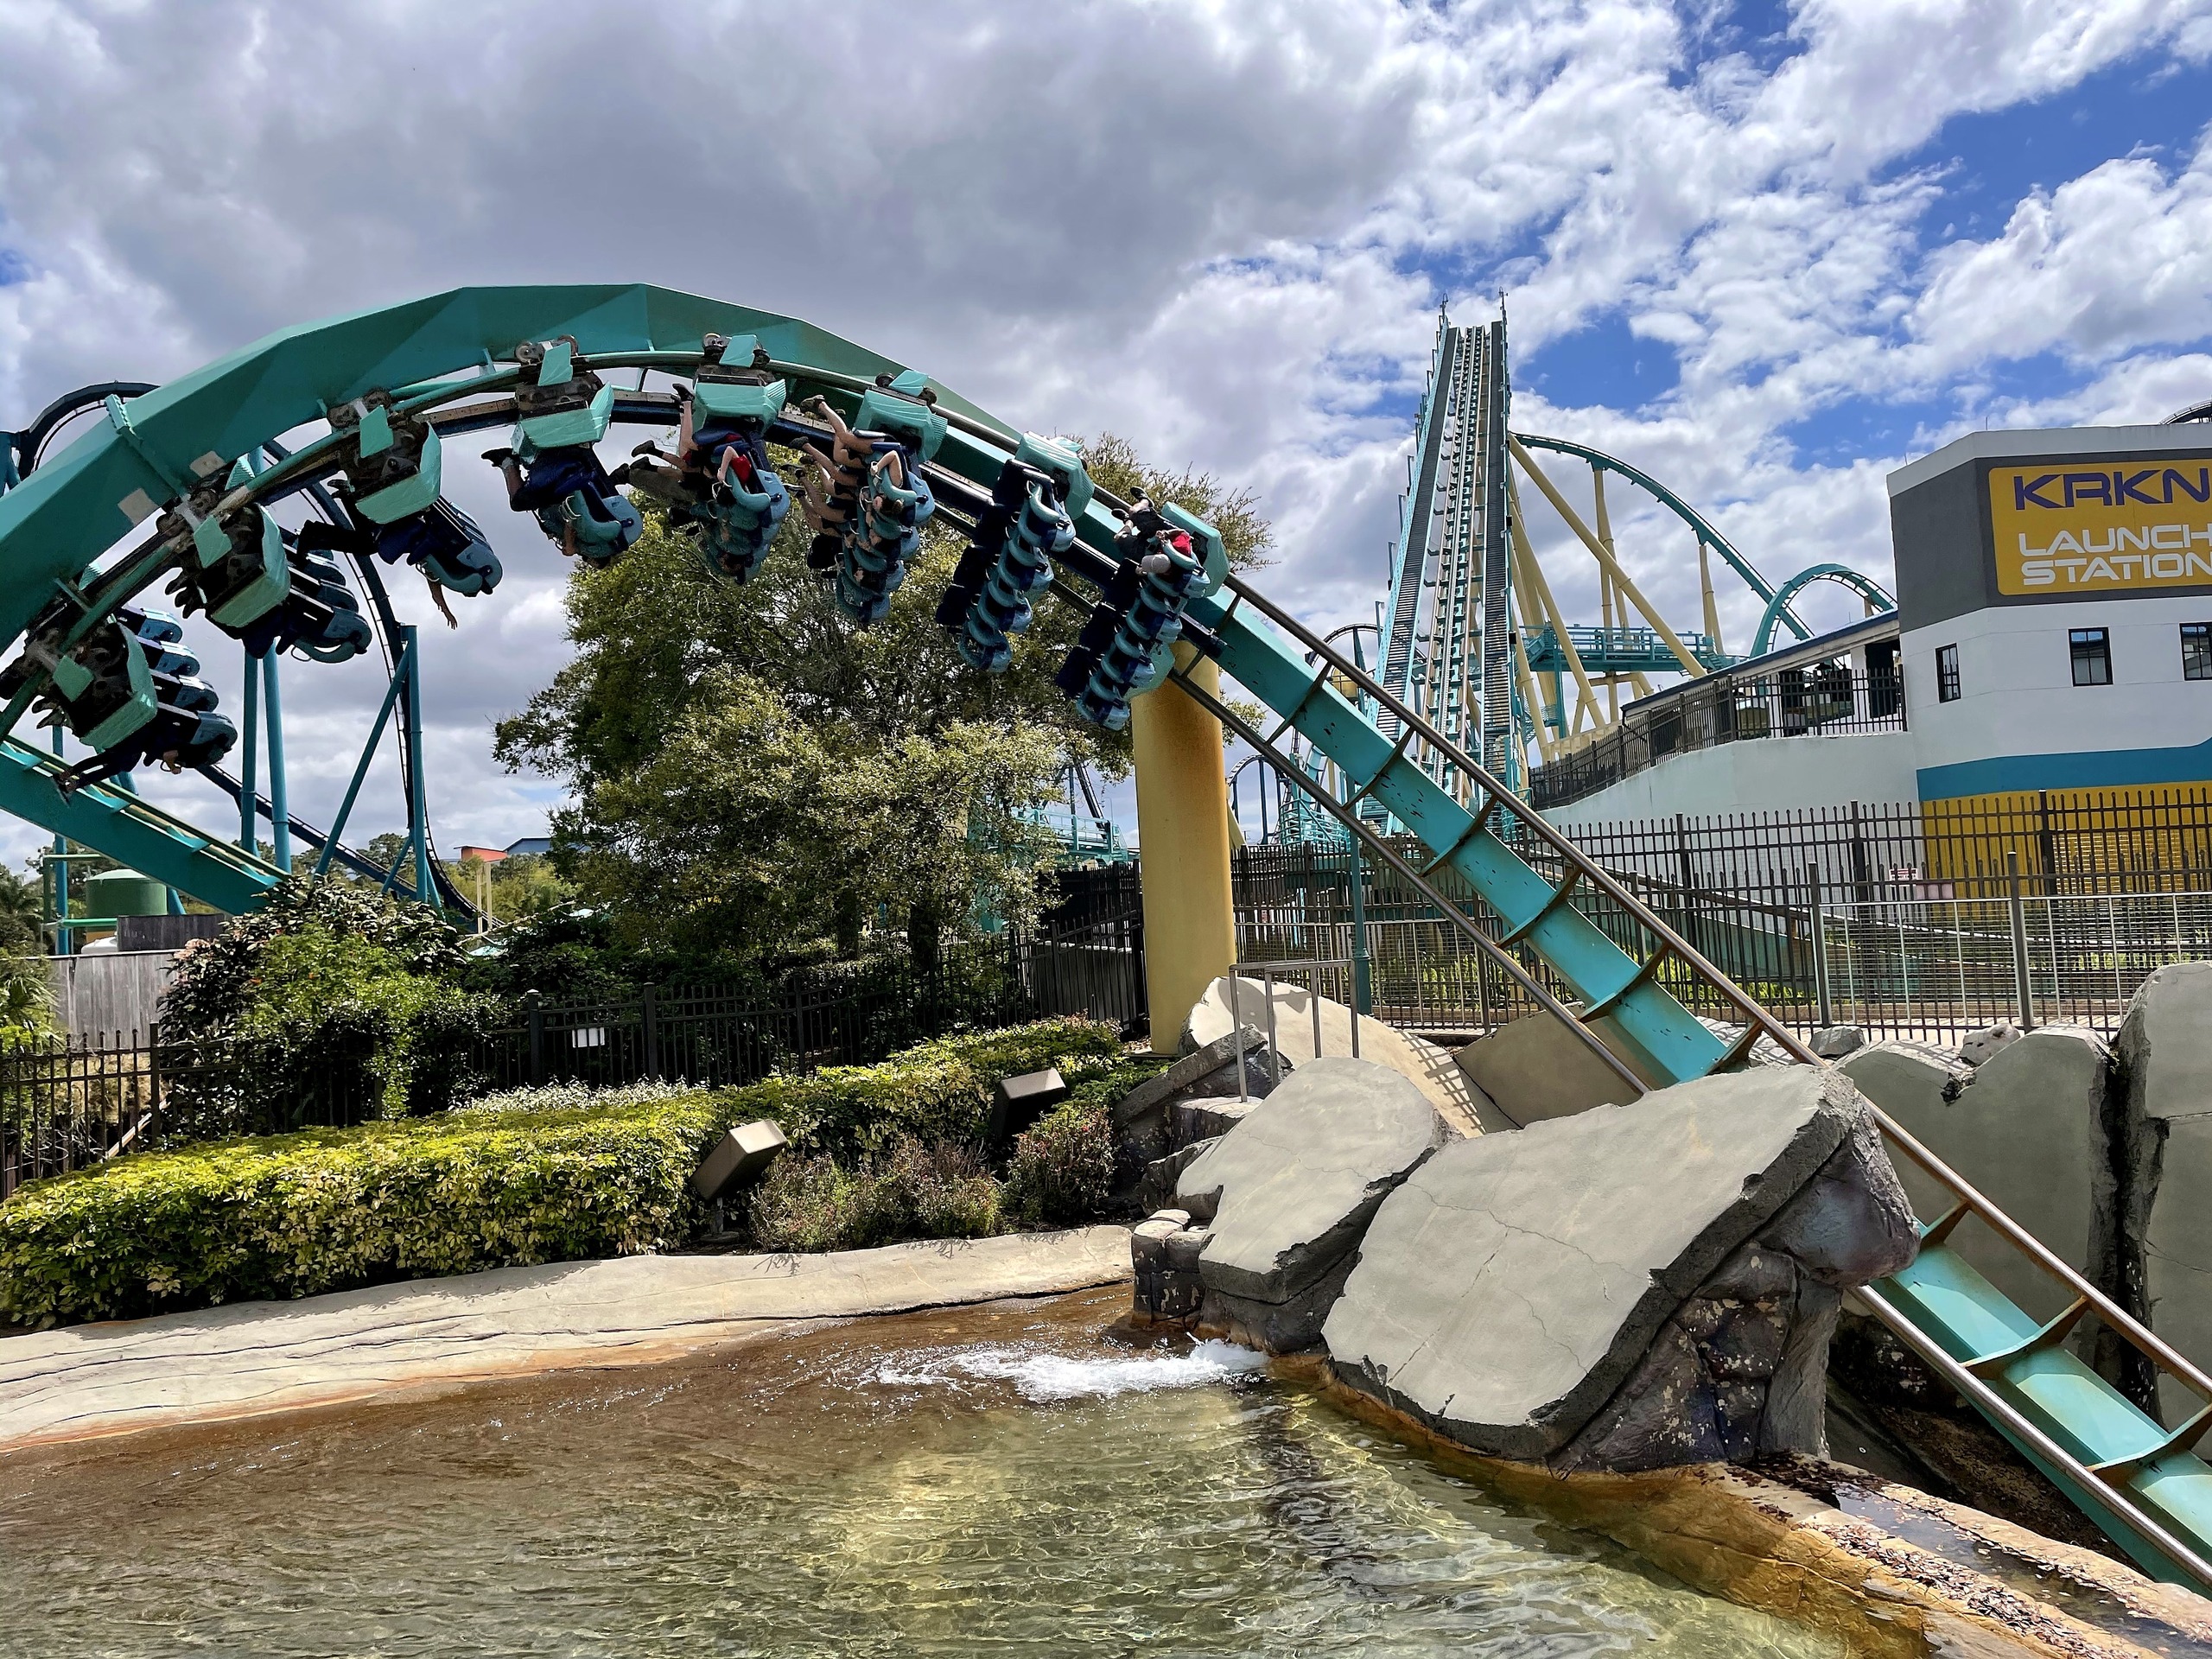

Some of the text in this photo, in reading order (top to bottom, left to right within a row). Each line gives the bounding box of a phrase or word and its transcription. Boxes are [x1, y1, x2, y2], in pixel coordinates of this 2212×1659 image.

[2013, 467, 2210, 511] KRKN
[2018, 523, 2212, 556] LAUNCH
[2021, 551, 2212, 586] STATION
